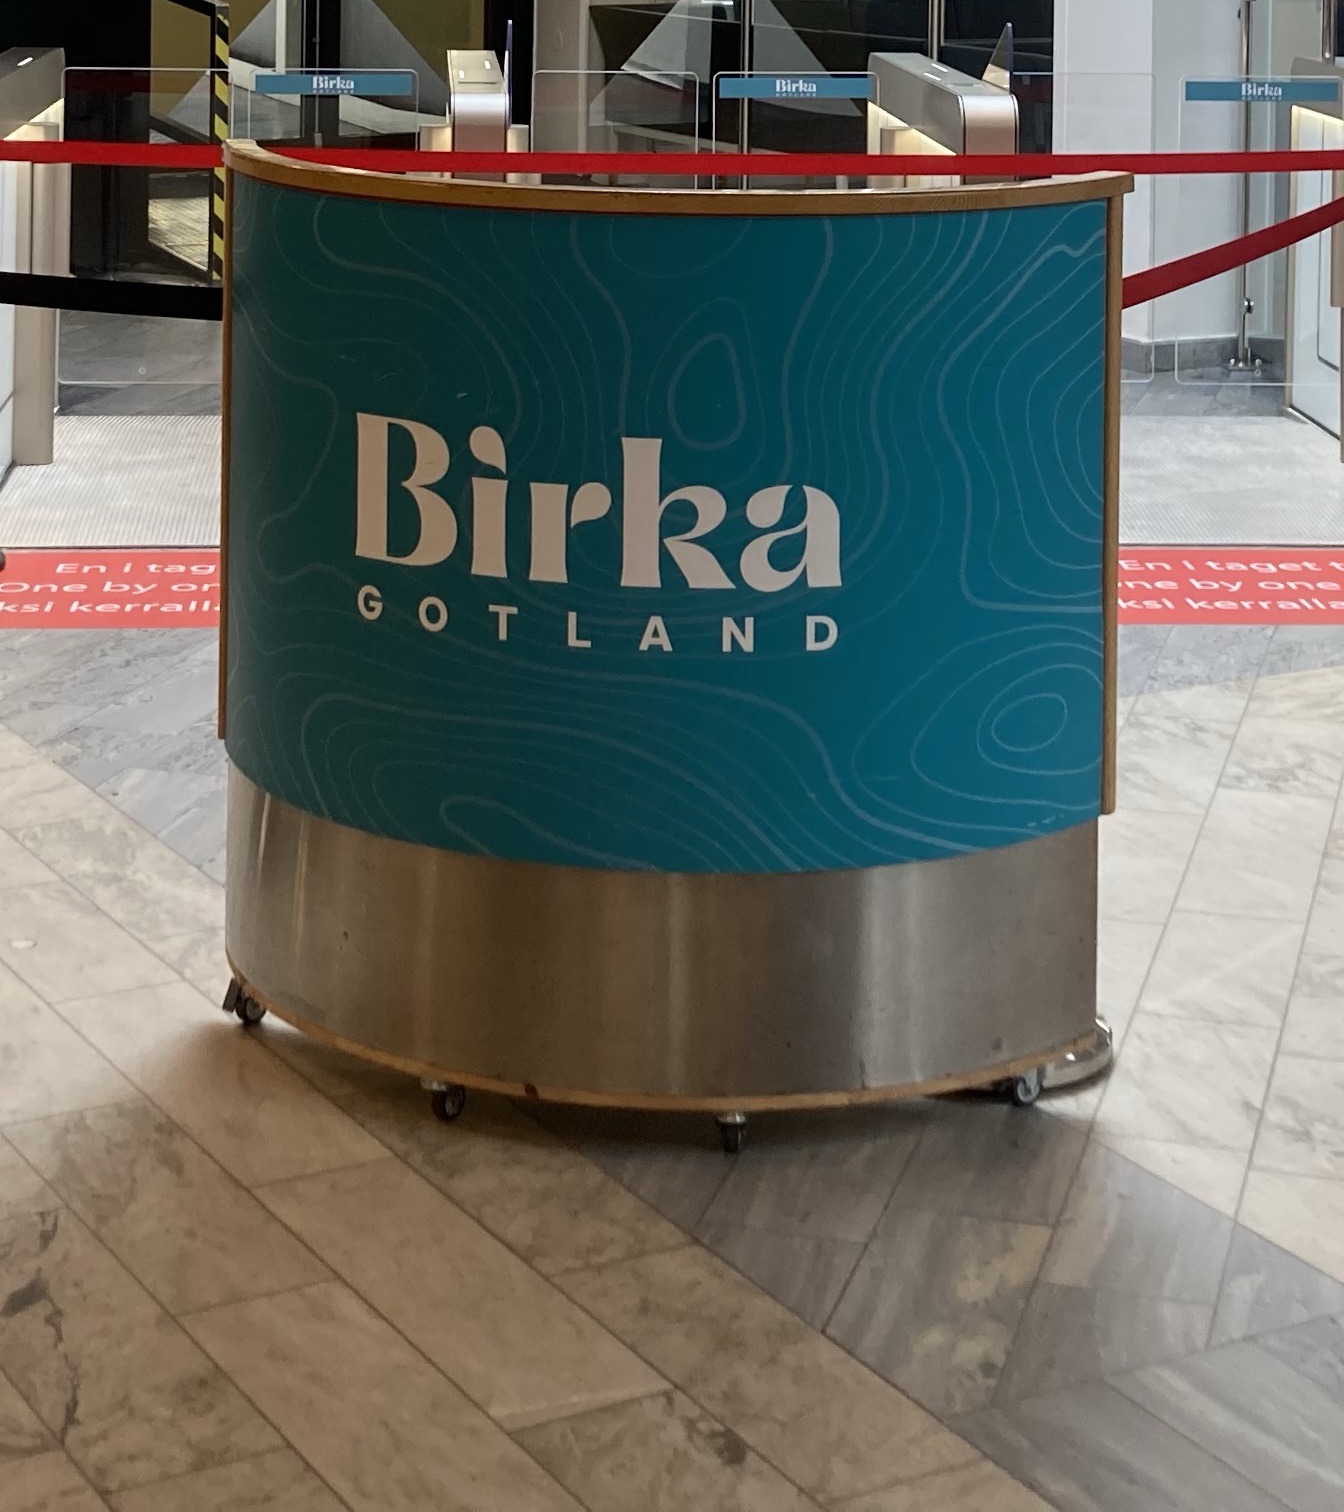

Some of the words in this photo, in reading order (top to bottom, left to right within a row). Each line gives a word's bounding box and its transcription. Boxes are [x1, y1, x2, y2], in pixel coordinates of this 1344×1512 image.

[312, 75, 355, 89] Birka
[775, 79, 817, 93] Birka
[1241, 82, 1283, 96] Birka
[355, 412, 843, 593] Birka
[56, 562, 107, 574] En
[123, 562, 133, 574] i
[147, 562, 217, 576] tag
[1119, 559, 1172, 571] En
[1205, 560, 1322, 573] taget
[102, 580, 159, 595] by
[170, 582, 220, 592] on
[1118, 579, 1179, 590] ne
[1189, 577, 1243, 592] by
[1258, 579, 1342, 591] one
[69, 600, 220, 613] kerrall
[1118, 596, 1175, 610] ksi
[357, 584, 839, 653] GOTLAND
